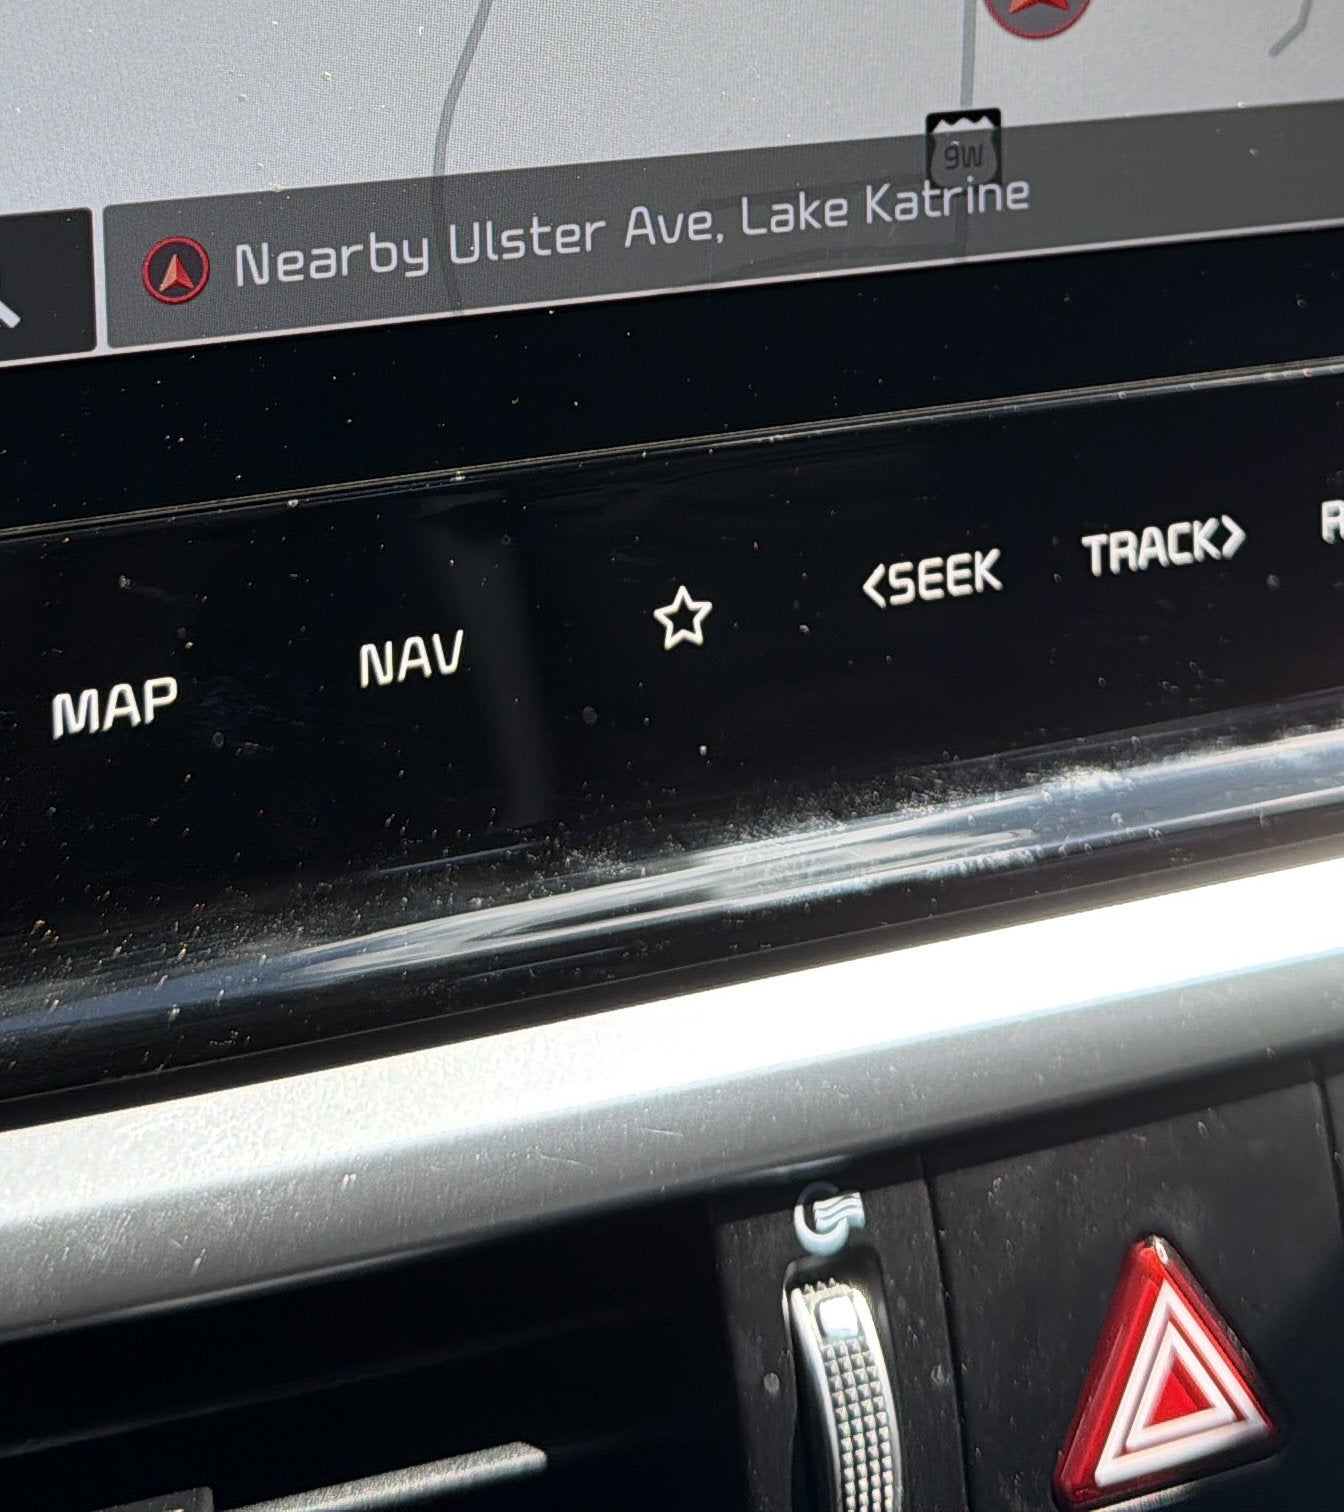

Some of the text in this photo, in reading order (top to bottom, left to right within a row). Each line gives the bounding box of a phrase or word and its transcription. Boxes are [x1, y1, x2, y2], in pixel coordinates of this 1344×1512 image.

[943, 143, 984, 171] 9W
[235, 175, 1031, 287] Nearby Ulster Ave, Lake Katrine
[359, 629, 464, 689] NAV
[52, 676, 179, 740] MAP
